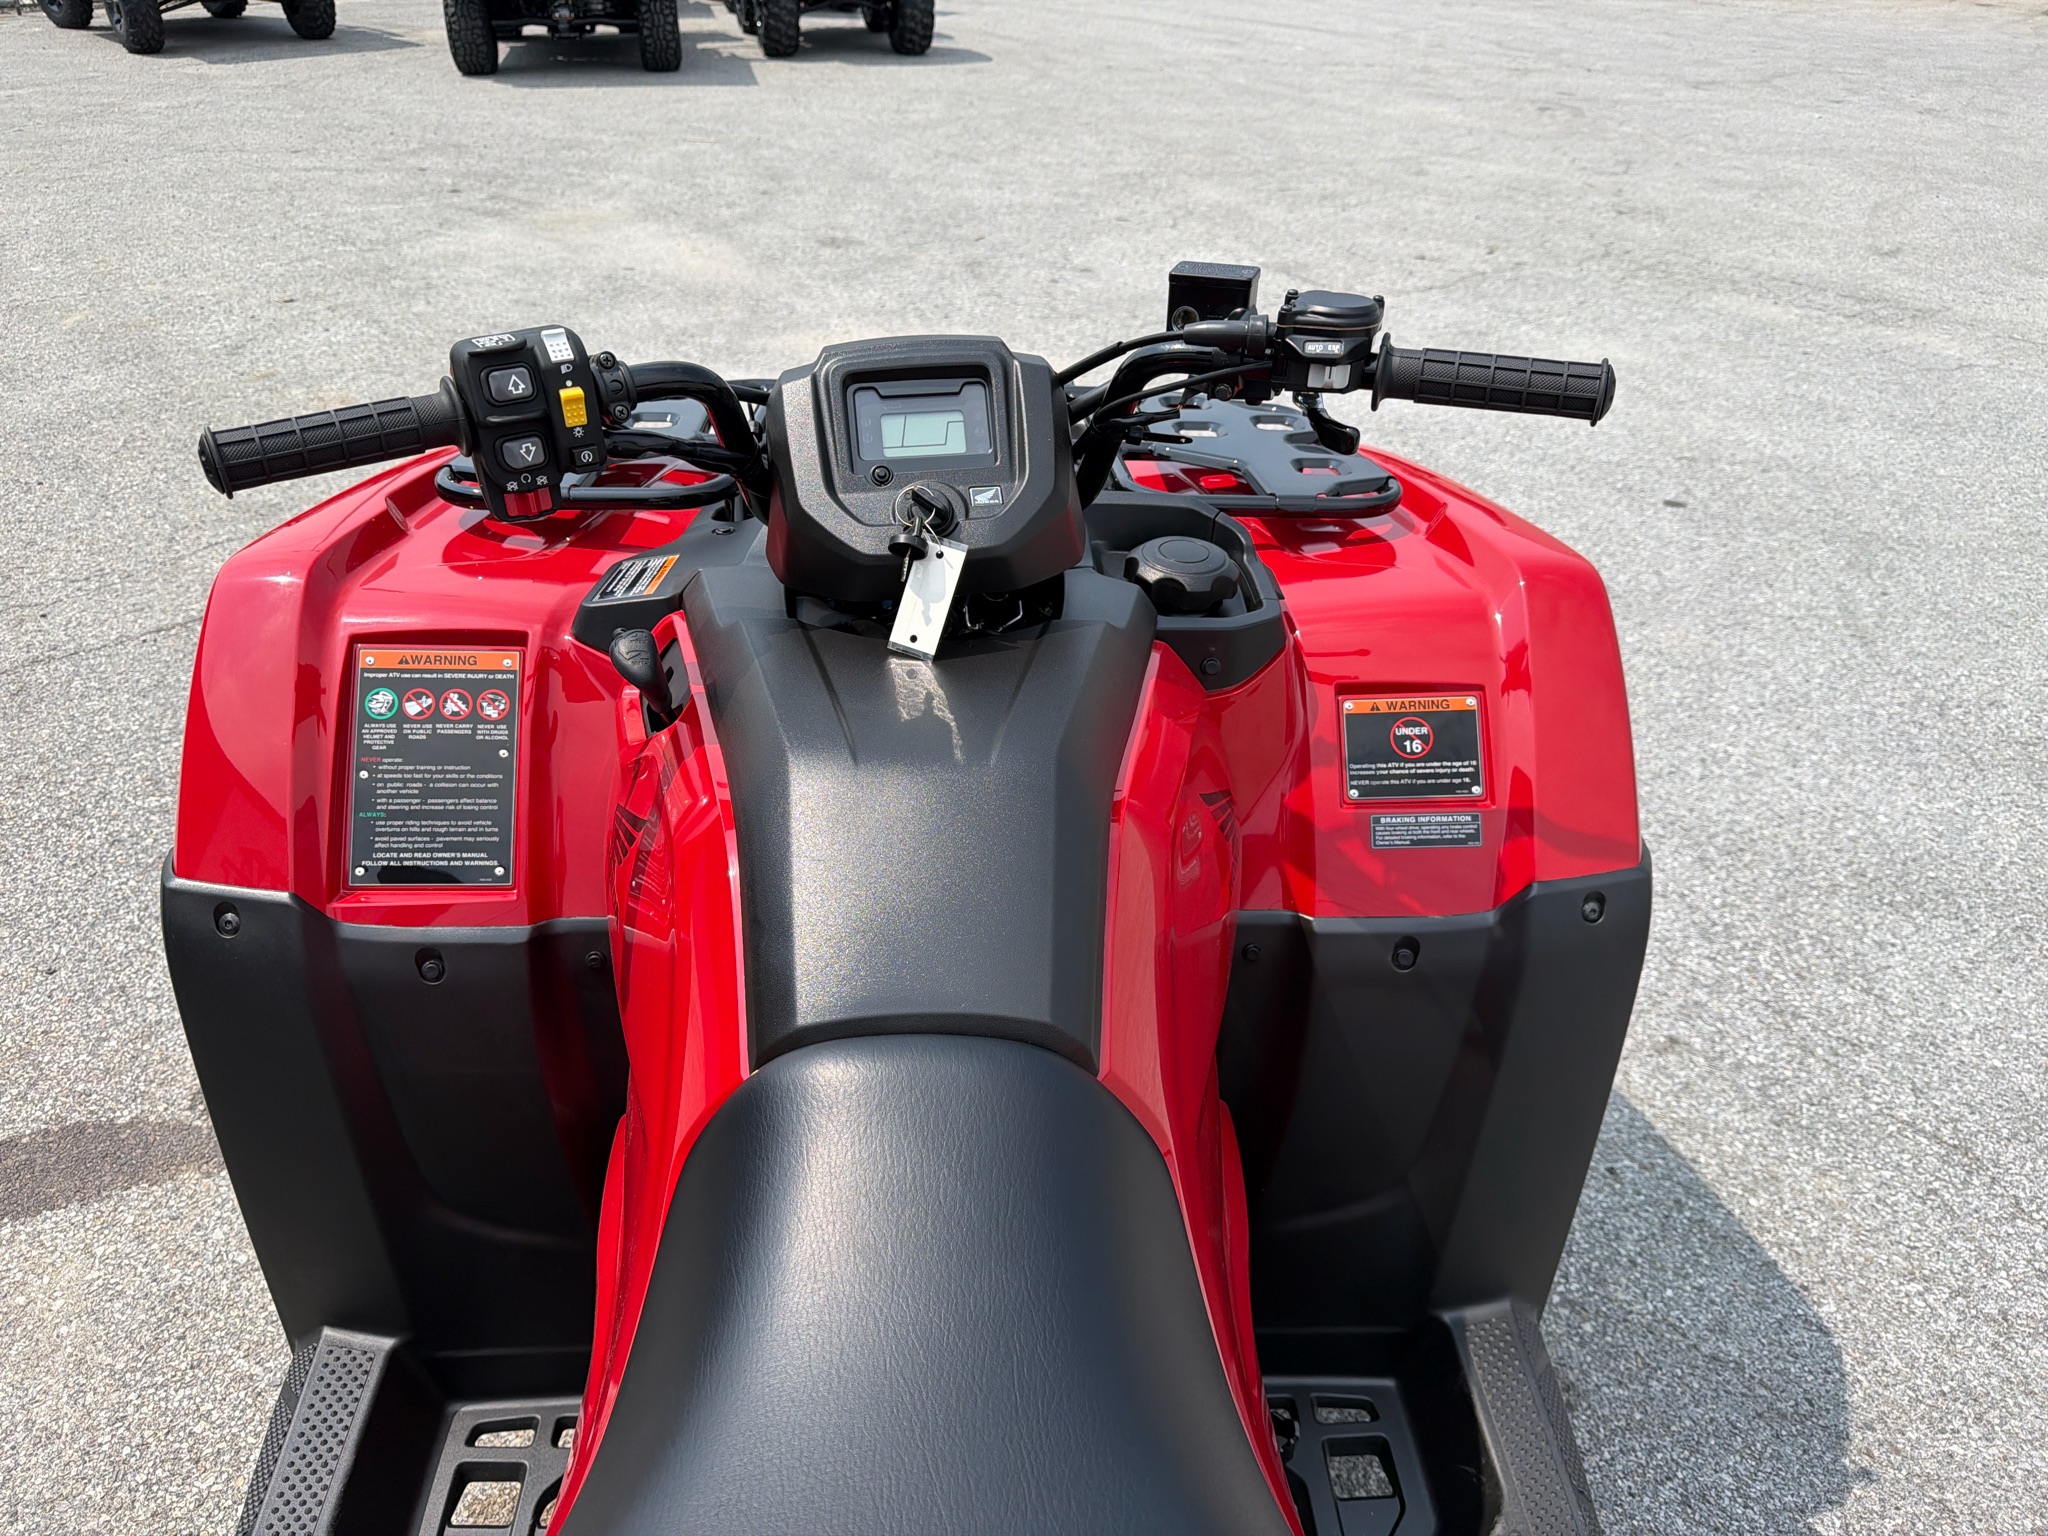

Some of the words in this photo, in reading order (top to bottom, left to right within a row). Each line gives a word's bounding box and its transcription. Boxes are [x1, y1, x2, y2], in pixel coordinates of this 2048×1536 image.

[410, 654, 478, 666] WARNING
[1386, 699, 1450, 711] WARNING
[1396, 727, 1428, 736] UNDER
[1404, 740, 1422, 753] 16
